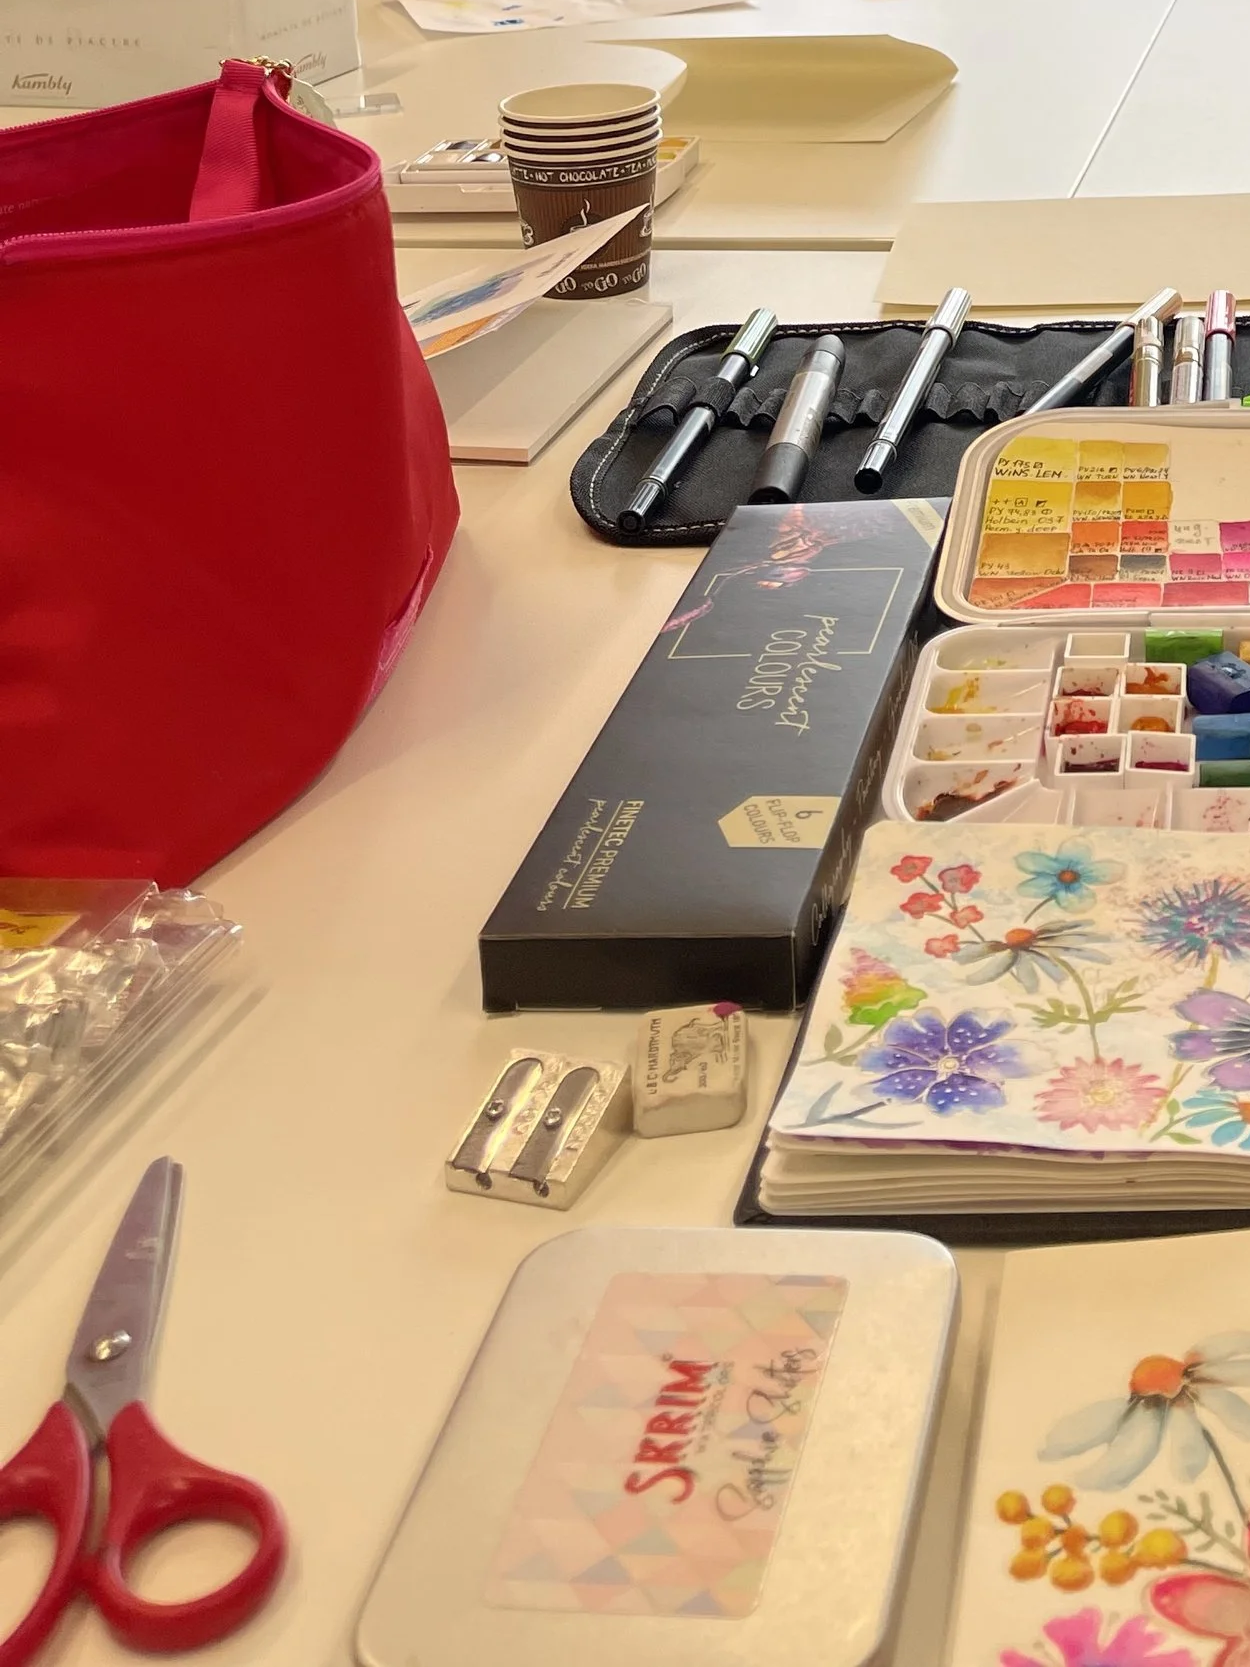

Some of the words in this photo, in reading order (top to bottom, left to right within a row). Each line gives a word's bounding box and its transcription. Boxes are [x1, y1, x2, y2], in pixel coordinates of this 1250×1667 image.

[11, 72, 73, 96] Kambly
[535, 172, 554, 183] HOT
[559, 166, 619, 183] CHOCOLATE
[625, 162, 642, 175] TEA
[594, 272, 618, 293] GO
[736, 629, 807, 710] COLOURS
[775, 614, 842, 736] pearlescent
[563, 798, 608, 868] pearlescent
[604, 799, 645, 847] FINETEC
[743, 803, 776, 845] COLOURS
[765, 798, 801, 843] FLIP-FLOP
[795, 810, 824, 820] 6
[570, 849, 619, 909] PREMIUM
[624, 1359, 718, 1505] SKRIM
